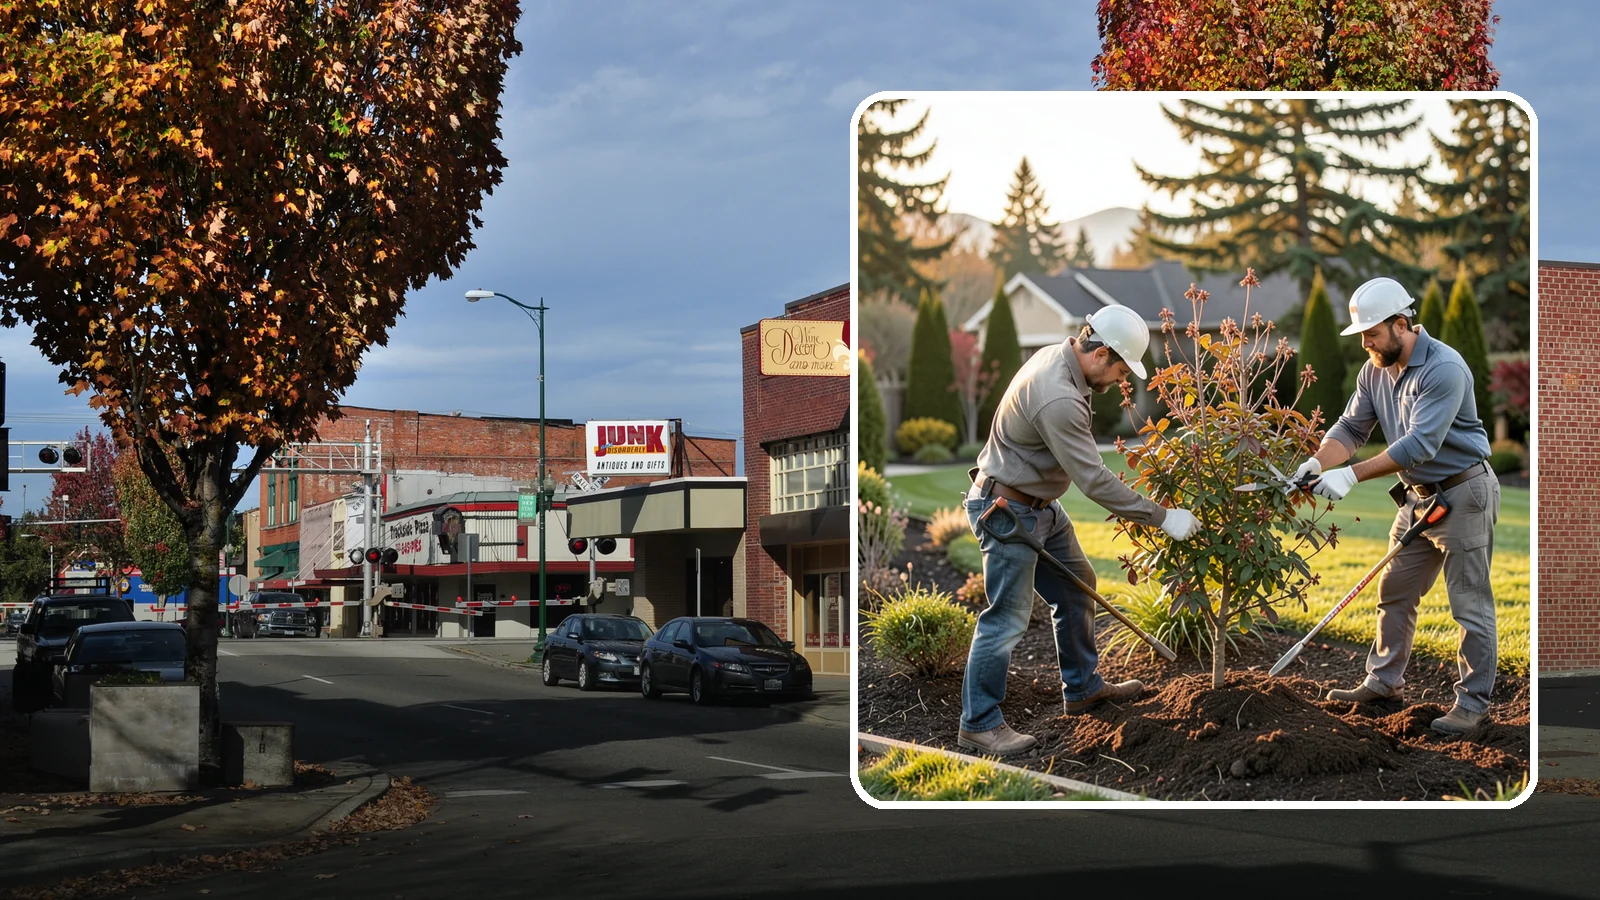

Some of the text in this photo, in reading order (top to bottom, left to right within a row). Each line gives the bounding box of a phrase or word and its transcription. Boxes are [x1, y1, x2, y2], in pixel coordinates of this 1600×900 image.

[595, 425, 666, 457] JUNK
[607, 446, 646, 454] DISORDERLY
[596, 461, 665, 470] ANTIQUES AND GIFTS
[390, 519, 429, 539] Trackside Pizza
